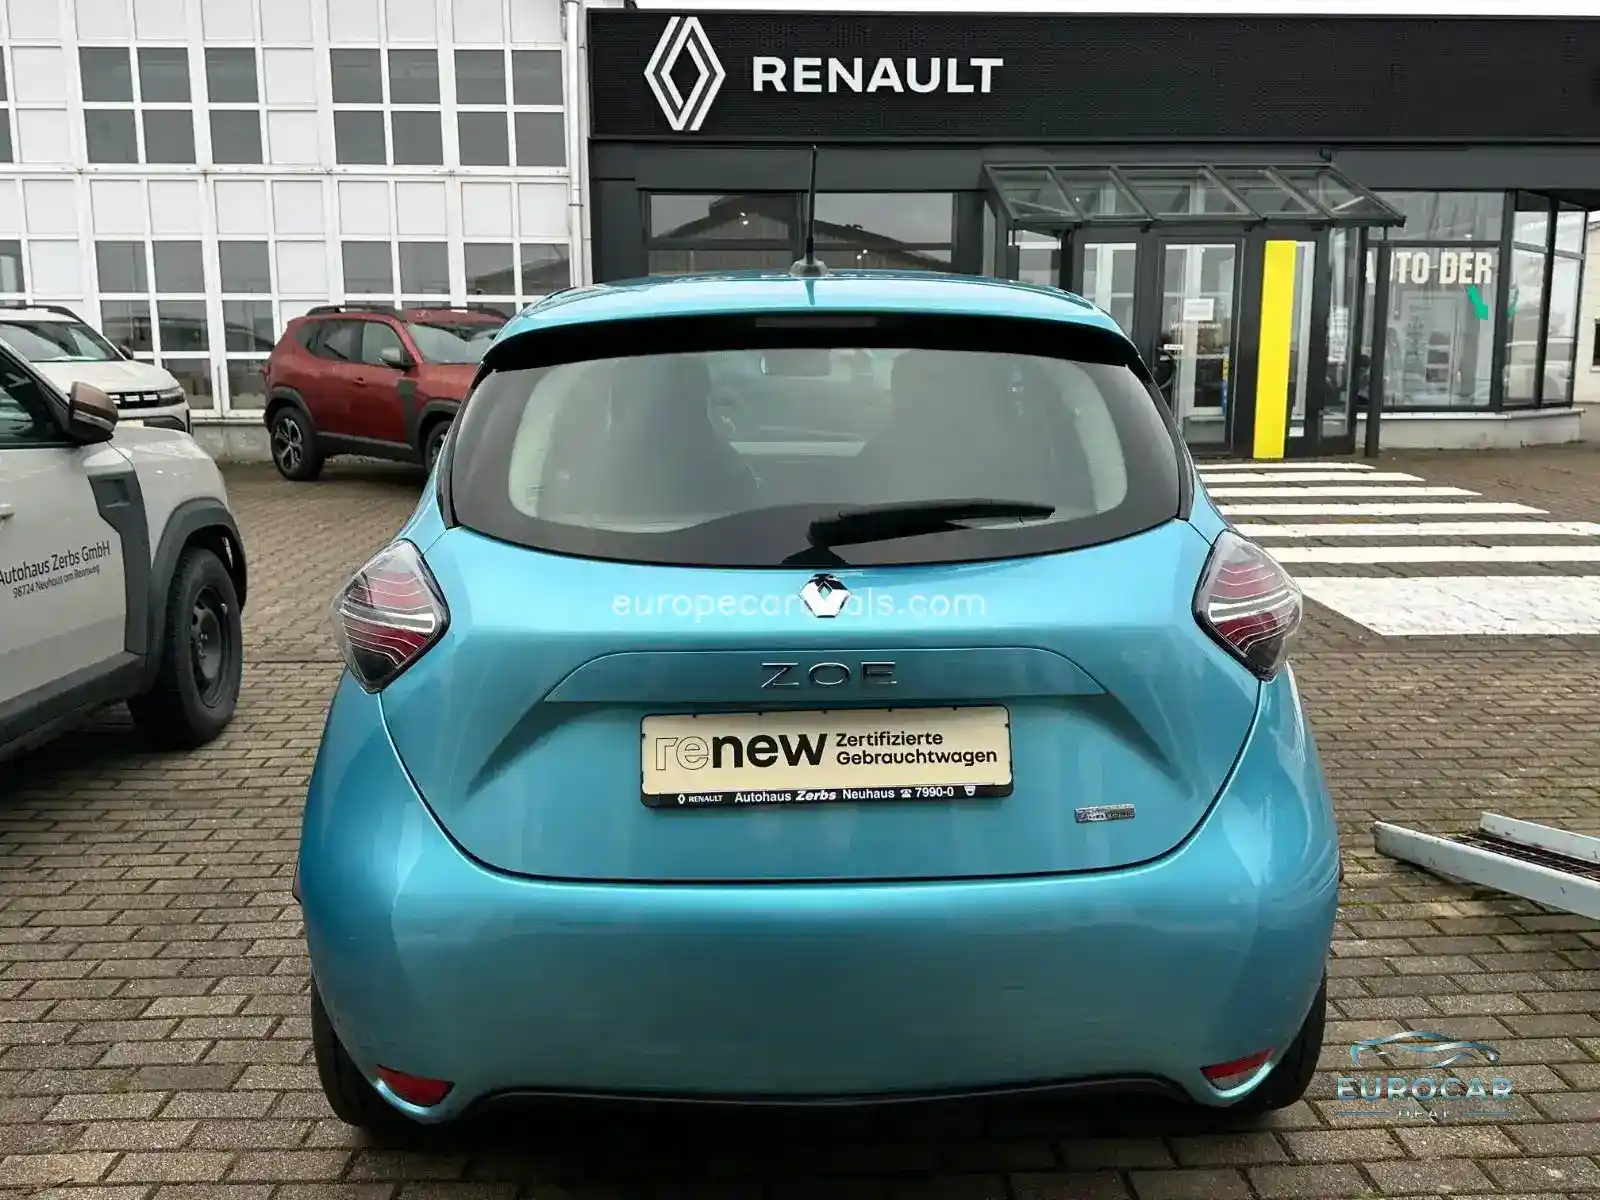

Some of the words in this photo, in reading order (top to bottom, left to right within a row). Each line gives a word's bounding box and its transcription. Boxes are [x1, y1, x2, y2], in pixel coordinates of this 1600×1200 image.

[753, 56, 1004, 93] RENAULT
[1366, 250, 1430, 284] ATO
[1438, 251, 1492, 284] DER
[0, 560, 50, 586] Autohaus
[51, 549, 80, 572] Zerbs
[81, 541, 111, 562] GmbH
[760, 661, 898, 689] ZOE
[655, 733, 828, 771] renew
[836, 731, 944, 748] Zertifizierte
[836, 748, 998, 767] Gebrauchtwagen
[688, 794, 723, 803] RENAULT
[735, 791, 792, 804] Autohaus
[795, 789, 837, 801] Zerbs
[842, 788, 895, 800] Neuhaus
[914, 786, 955, 798] 7990-0
